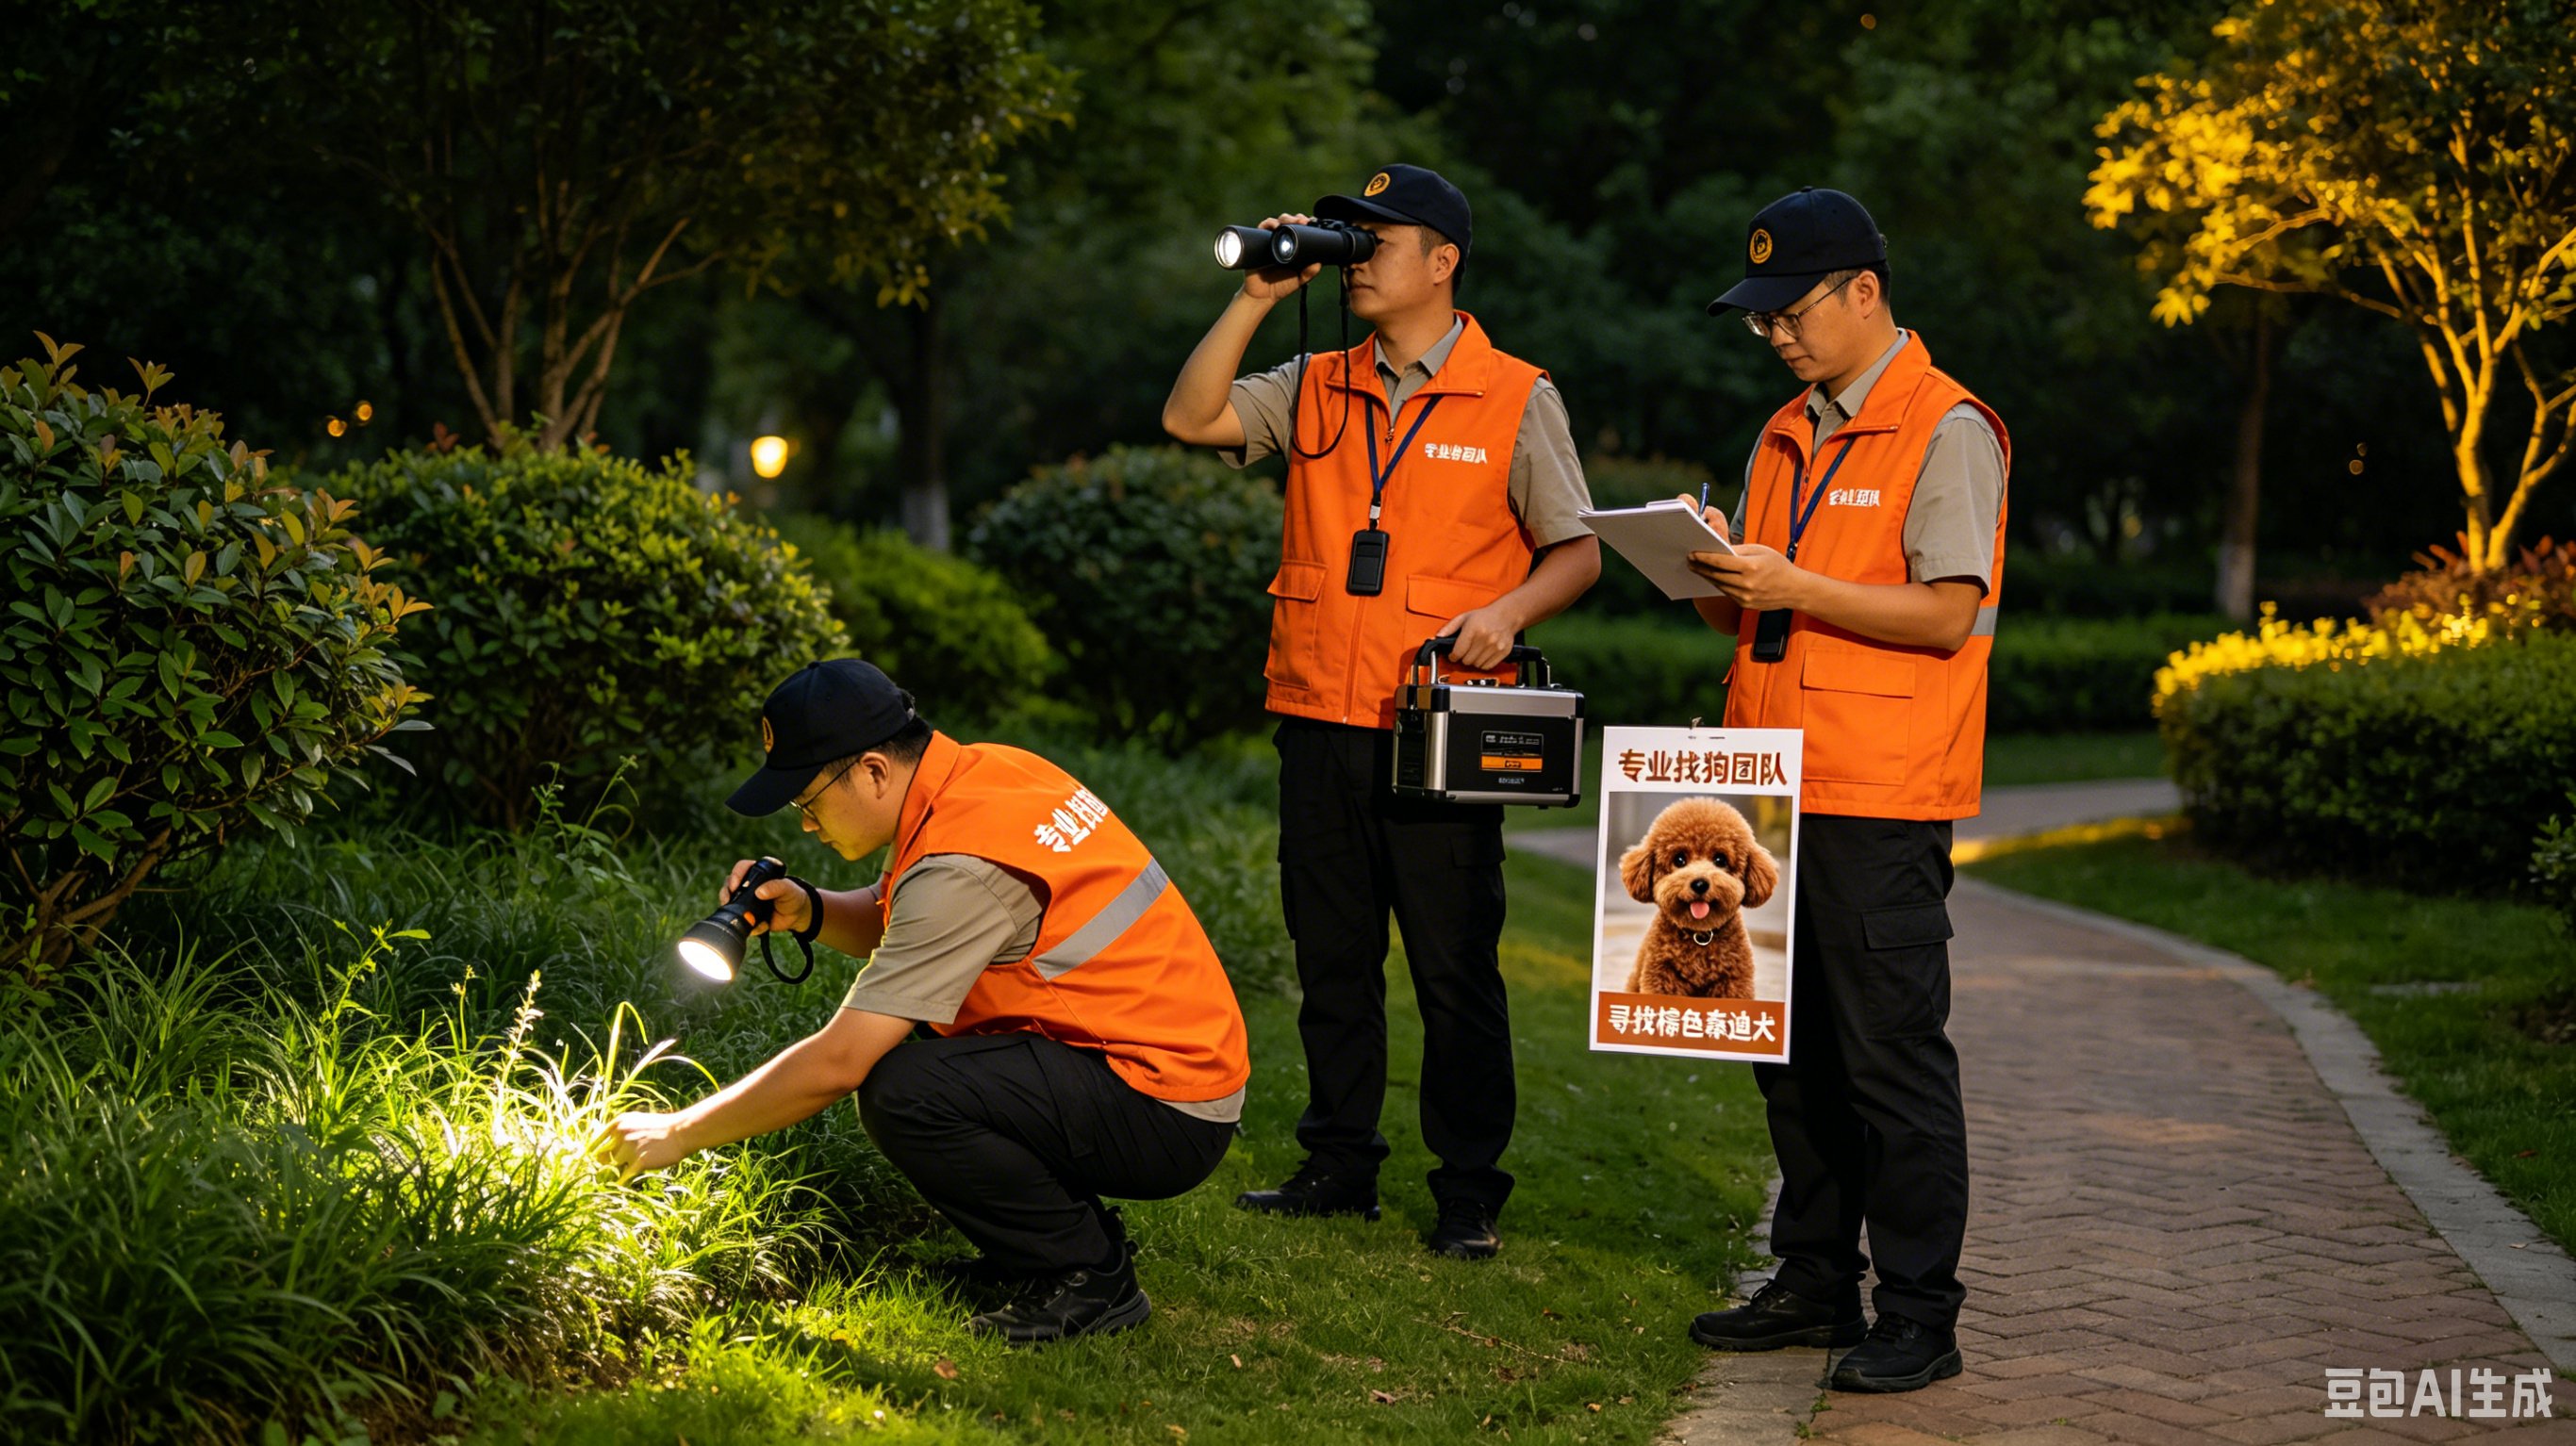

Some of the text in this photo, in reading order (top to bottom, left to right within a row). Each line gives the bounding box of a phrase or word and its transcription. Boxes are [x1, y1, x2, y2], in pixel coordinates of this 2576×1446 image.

[1618, 748, 1788, 786] 专业找狗团队
